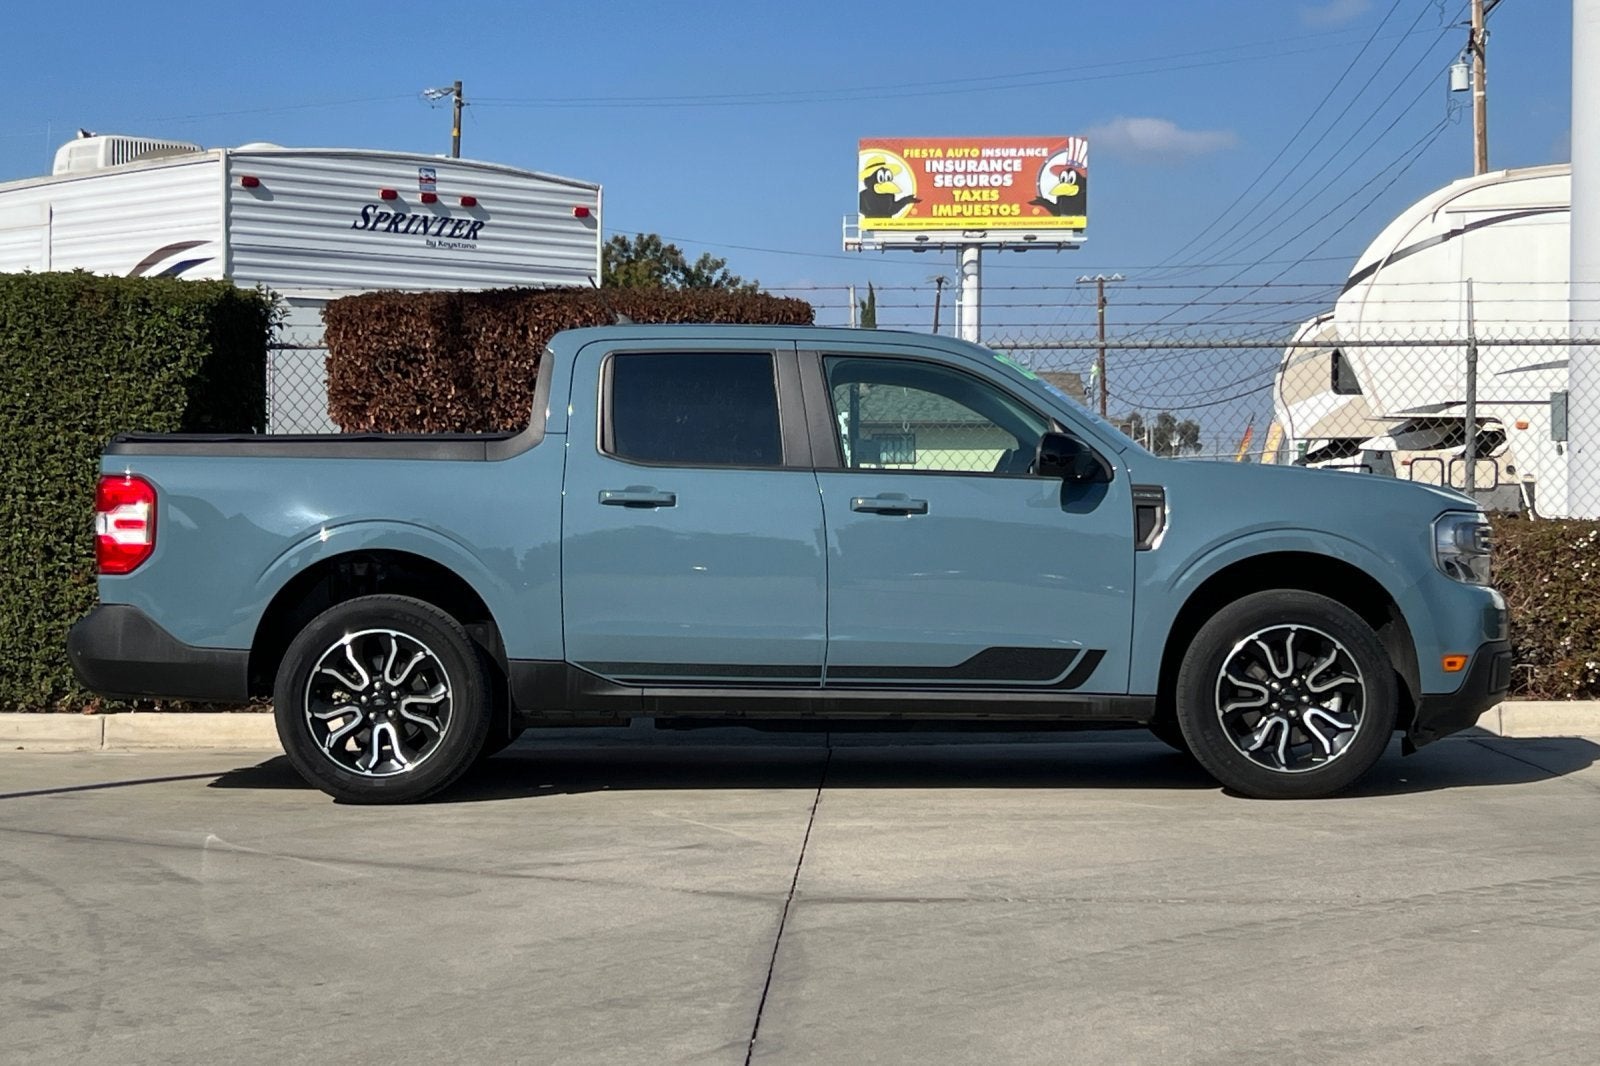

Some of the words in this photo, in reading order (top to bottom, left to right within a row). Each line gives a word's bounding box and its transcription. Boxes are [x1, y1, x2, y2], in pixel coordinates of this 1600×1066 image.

[903, 148, 943, 158] FIESTA
[946, 148, 980, 158] AUTO
[981, 147, 1049, 157] INSURANCE
[925, 159, 1022, 172] INSURANCE
[933, 174, 1013, 187] SEGUROS
[952, 189, 1000, 202] TAXES
[932, 203, 1020, 216] IMPUESTOS
[425, 239, 437, 248] by
[438, 240, 477, 249] Keystone
